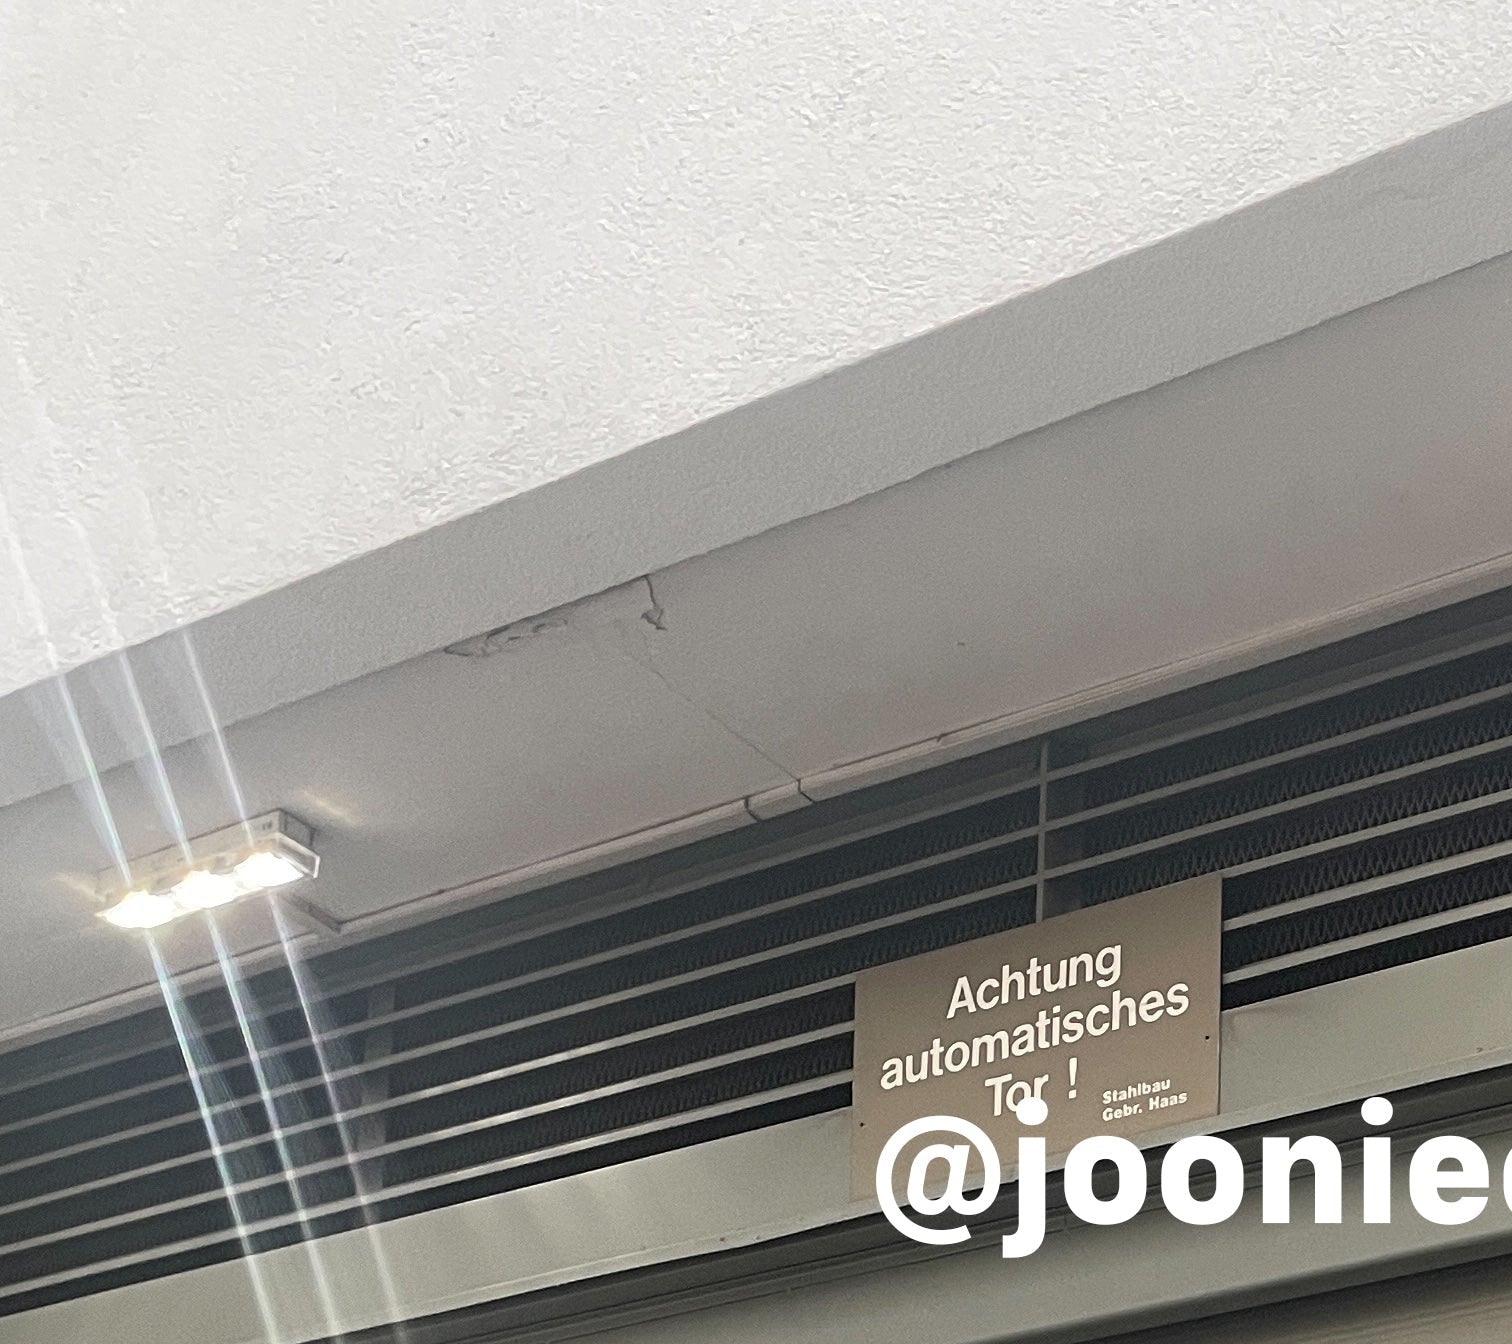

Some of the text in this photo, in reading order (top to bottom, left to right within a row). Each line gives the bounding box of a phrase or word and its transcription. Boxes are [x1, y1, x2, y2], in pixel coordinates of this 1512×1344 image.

[947, 944, 1122, 1019] Achtung
[880, 982, 1190, 1090] automatisches
[1102, 1079, 1171, 1105] Stahlbau
[1102, 1092, 1188, 1122] Gebr. Haas
